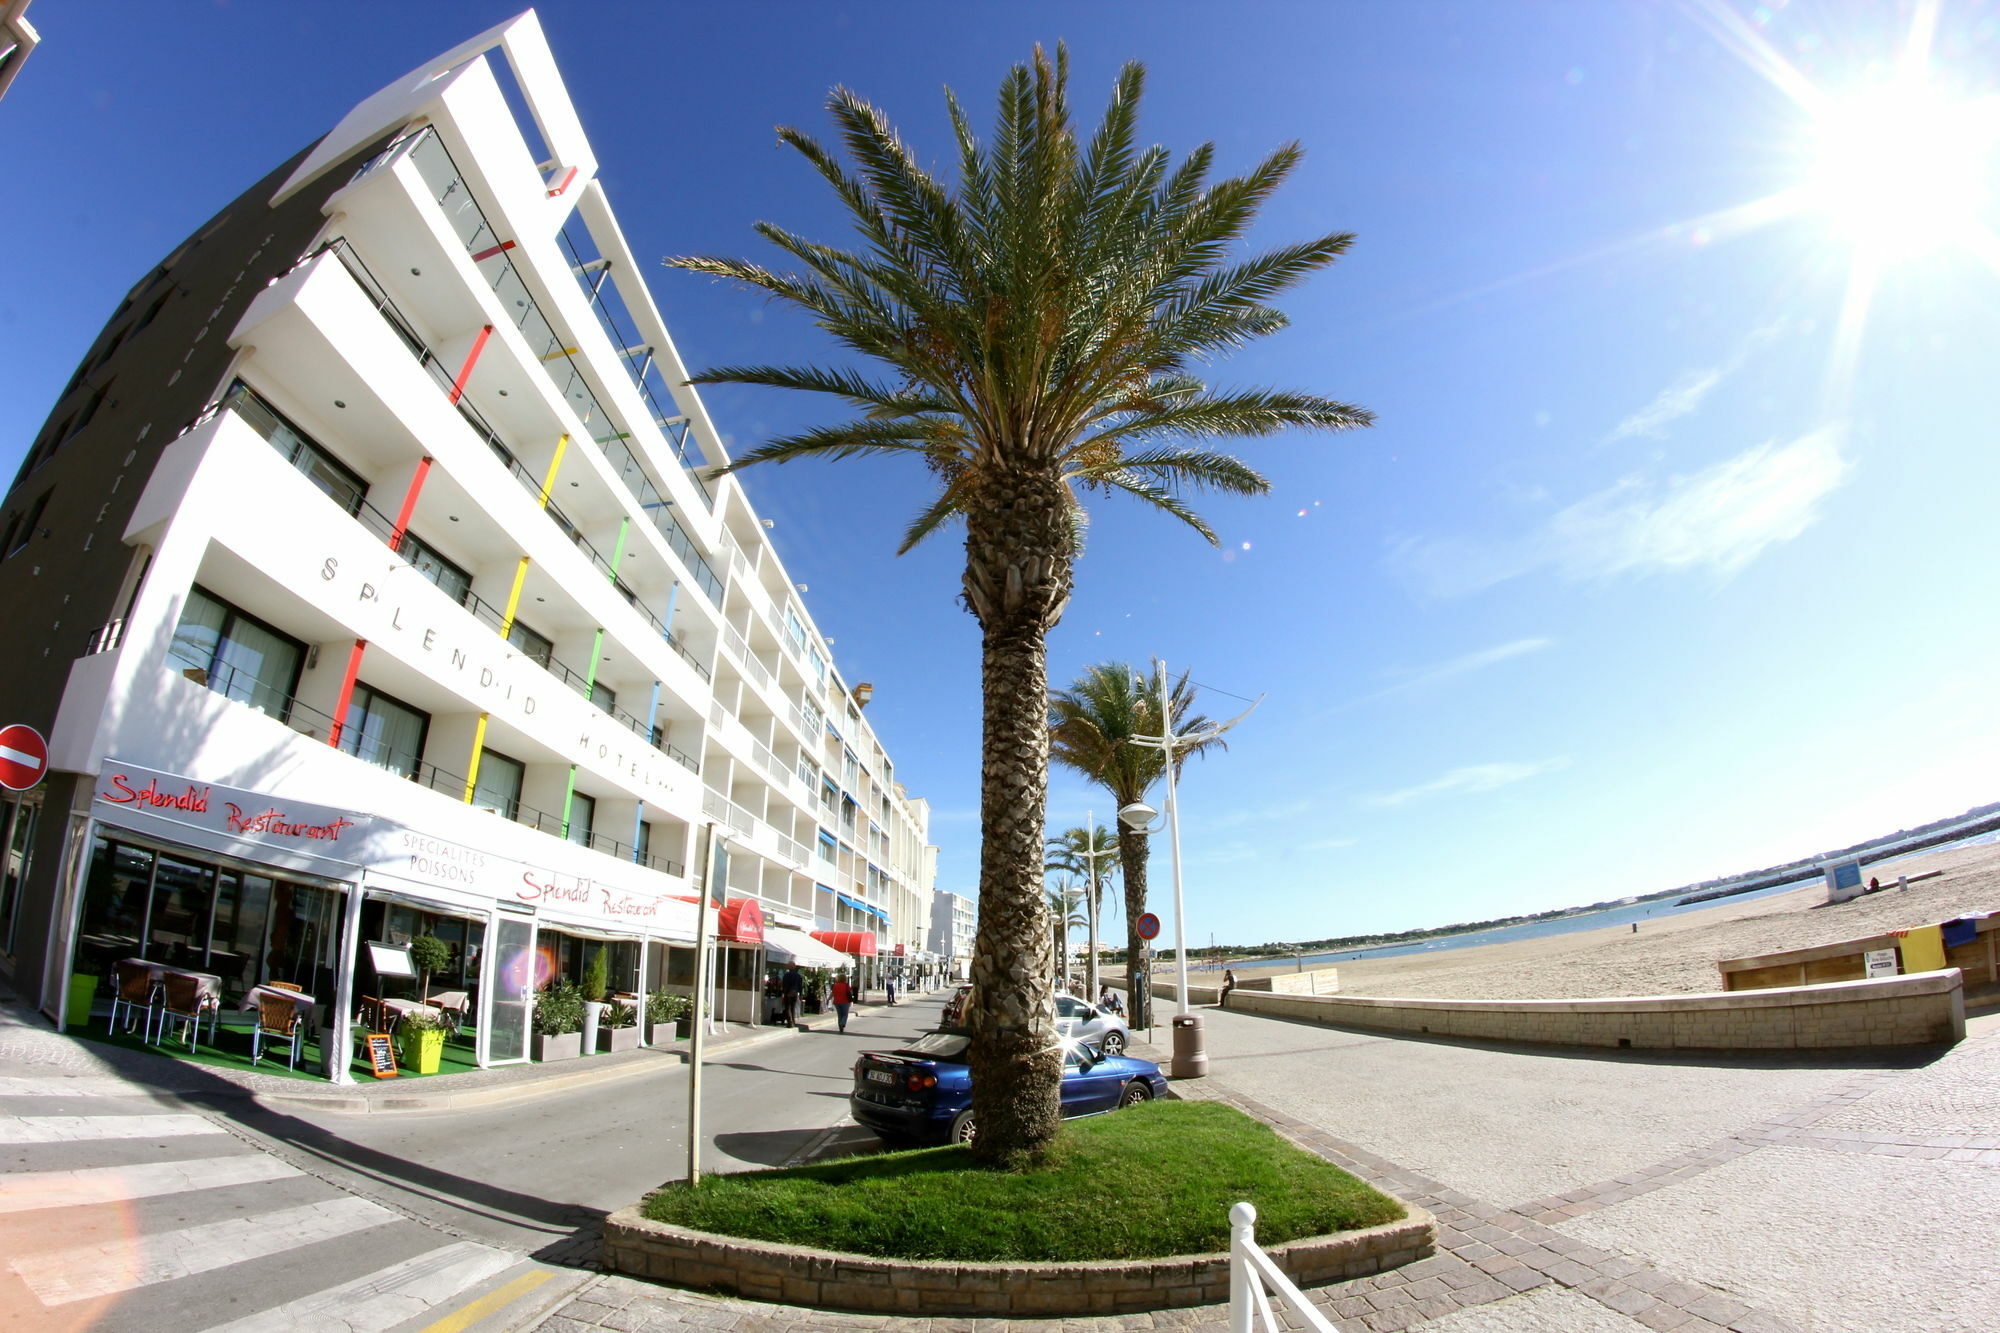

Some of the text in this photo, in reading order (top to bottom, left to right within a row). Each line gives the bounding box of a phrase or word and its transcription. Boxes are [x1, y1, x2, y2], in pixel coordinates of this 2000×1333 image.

[321, 557, 649, 784] SPLENDID HOTEL
[102, 775, 354, 841] Splendid Restaurant
[404, 834, 484, 867] SPECIALITES
[410, 855, 474, 884] POISSONS
[516, 871, 590, 902] Splendid
[601, 889, 662, 916] Restaurant
